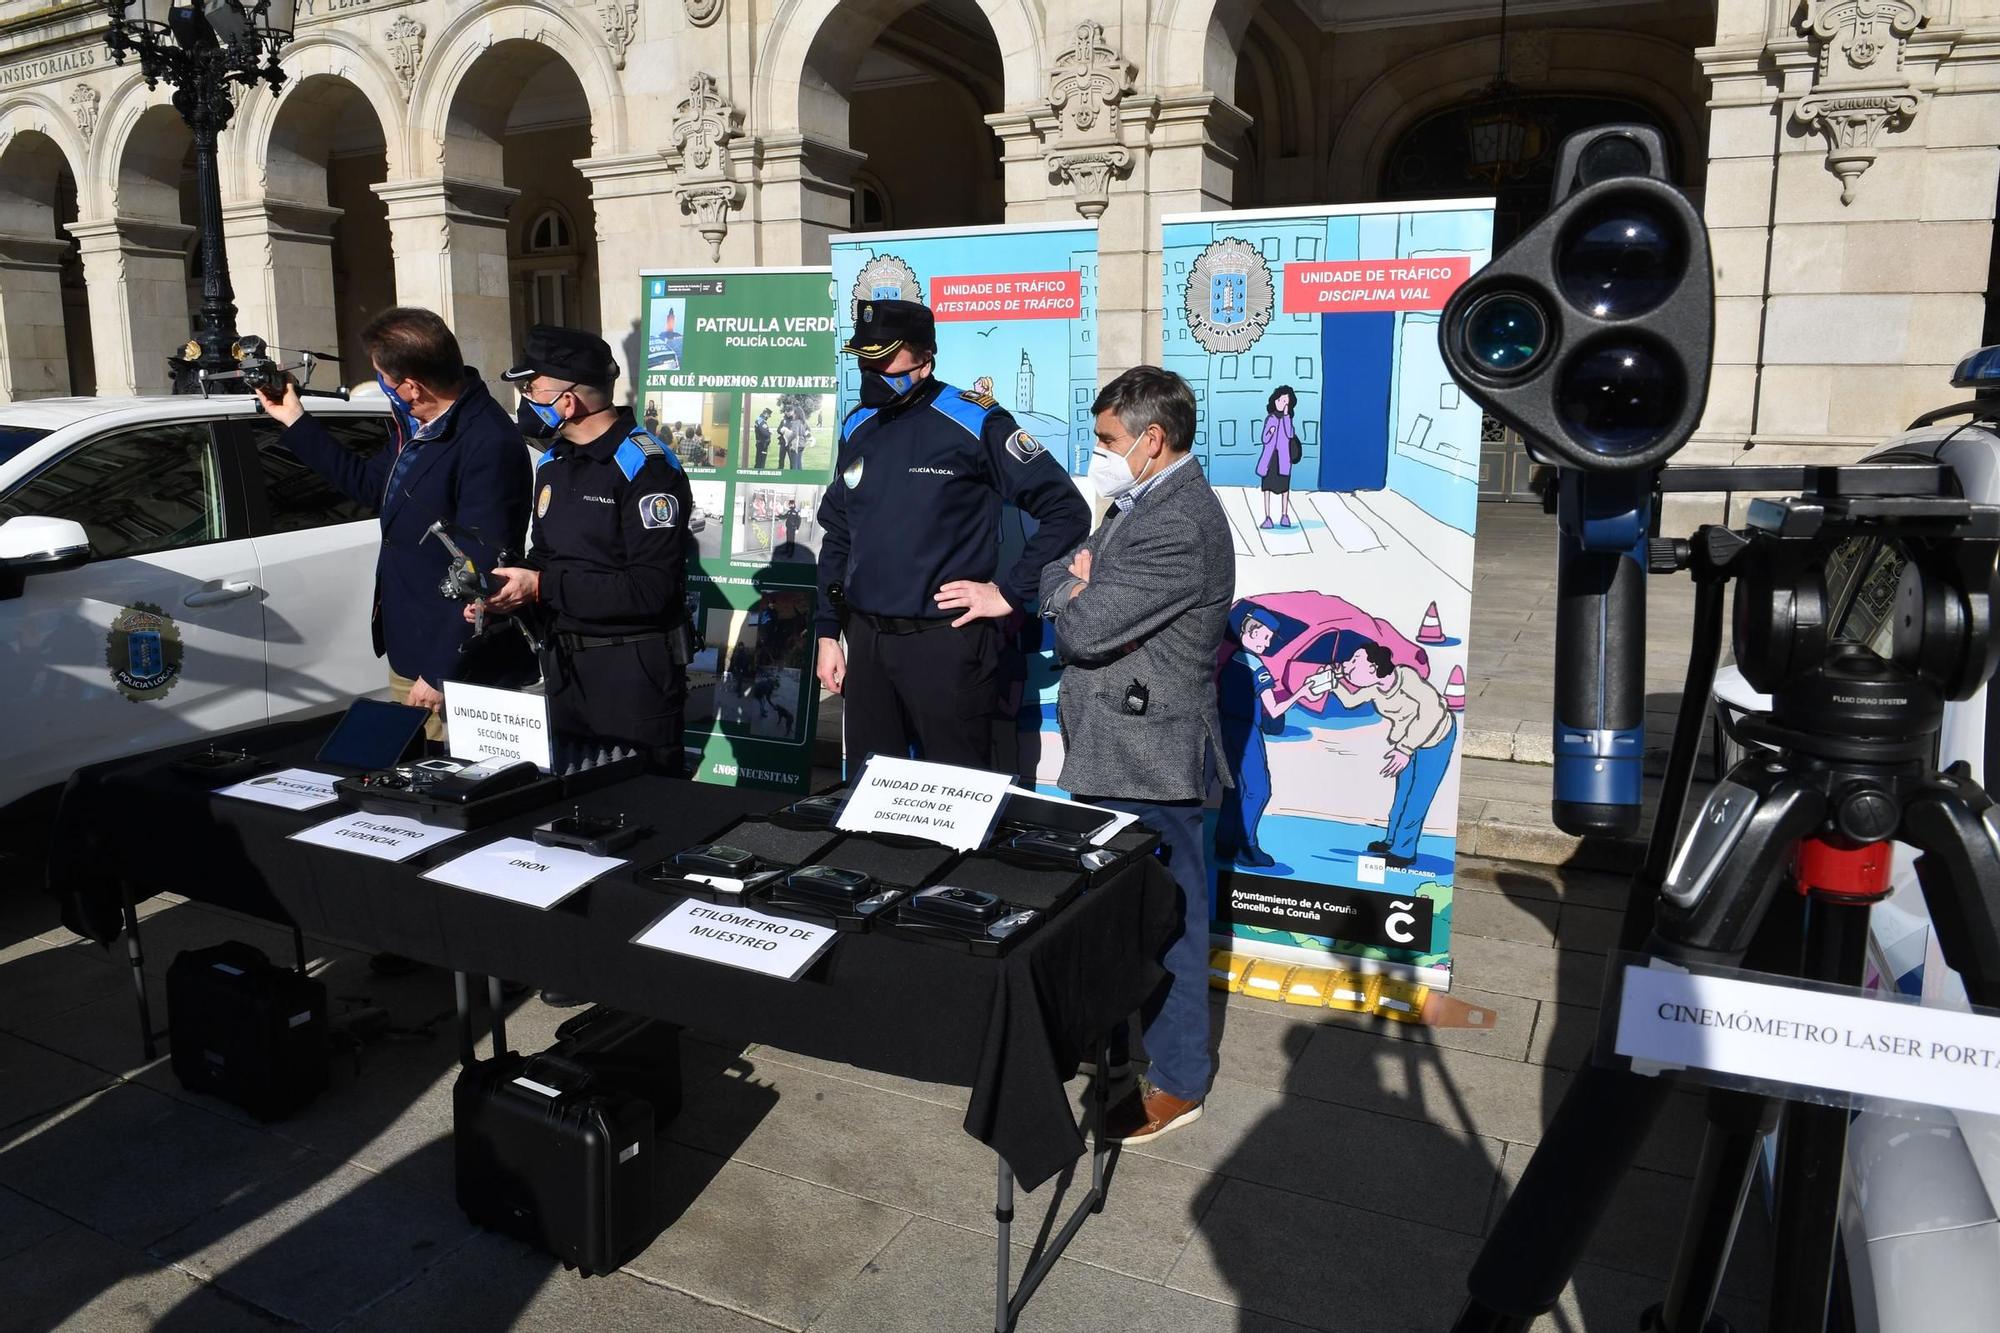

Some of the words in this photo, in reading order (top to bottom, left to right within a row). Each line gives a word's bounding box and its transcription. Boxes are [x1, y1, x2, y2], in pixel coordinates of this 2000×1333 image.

[0, 49, 95, 84] NSISTORIALES
[1300, 270, 1362, 284] UNIDADE
[1366, 270, 1385, 282] DE
[1388, 266, 1452, 281] TRÁFICO
[943, 283, 993, 296] UNIDADE
[996, 283, 1012, 294] DE
[1014, 279, 1065, 293] TRÁFICO
[1318, 289, 1395, 302] DISCIPLINA
[1399, 288, 1431, 300] VIAL
[935, 300, 1001, 313] ATESTADOS
[1004, 300, 1020, 311] DE
[1023, 297, 1074, 310] TRÁFICO
[696, 317, 780, 332] PATRULLA
[725, 335, 769, 347] POLICÍA
[770, 337, 807, 347] LOCAL
[646, 374, 666, 387] ¿EN
[669, 372, 696, 388] QUÉ
[699, 375, 758, 388] PODEMOS
[760, 375, 836, 389] AYUDARTE?
[687, 575, 728, 584] PROTECCIÓN
[154, 663, 176, 685] LOCAL
[1833, 695, 1855, 703] FLUID
[454, 706, 489, 721] UNIDAD
[490, 712, 502, 723] DE
[503, 714, 542, 729] TRÁFICO
[477, 728, 508, 741] SECCIÓN
[510, 734, 519, 743] DE
[479, 744, 520, 759] ATESTADOS
[712, 763, 738, 776] ¿NOS
[738, 766, 800, 784] NECESITAS?
[871, 777, 919, 791] UNIDAD
[920, 783, 938, 794] DE
[941, 786, 993, 803] TRÁFICO
[892, 797, 936, 810] SECCIÓN
[938, 803, 953, 812] DE
[874, 810, 929, 825] DISCIPLINA
[933, 818, 955, 829] VIAL
[334, 828, 401, 847] EVIDENCIAL
[351, 820, 425, 839] ETILÓMETRO
[508, 858, 551, 872] DRON
[1386, 866, 1407, 874] PABLO
[1408, 869, 1436, 878] PICASSO
[1231, 900, 1271, 914] Concello
[1272, 903, 1285, 915] da
[1286, 906, 1321, 921] Coruña
[1232, 889, 1298, 907] Ayuntamiento
[1299, 897, 1312, 909] de
[1314, 901, 1322, 910] A
[1323, 902, 1358, 915] Coruña
[689, 907, 789, 935] ETILÓMETRO
[789, 928, 815, 941] DE
[689, 925, 778, 951] MUESTREO
[1658, 1002, 1838, 1046] CINEMÓMETRO
[1844, 1030, 1923, 1058] LASER
